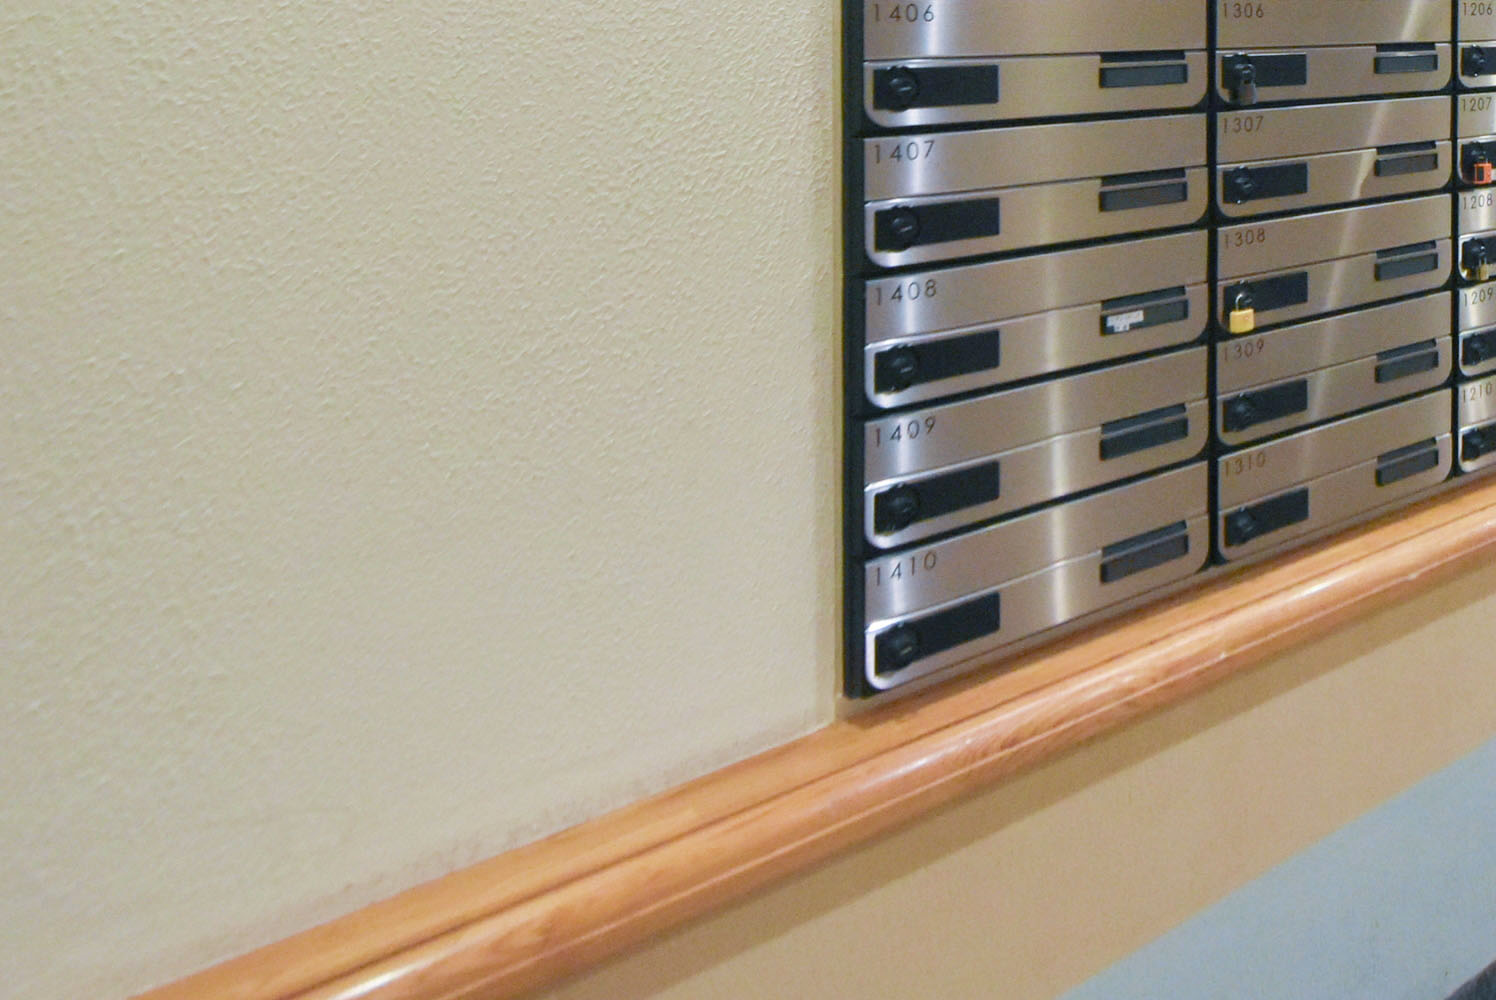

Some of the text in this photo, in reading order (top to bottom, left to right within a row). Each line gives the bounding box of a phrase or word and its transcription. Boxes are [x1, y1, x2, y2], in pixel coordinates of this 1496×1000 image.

[874, 3, 935, 23] 1406
[1222, 3, 1265, 19] 1306
[1462, 2, 1493, 17] 1206
[1462, 96, 1493, 113] 1207
[1222, 116, 1265, 134] 1307
[874, 140, 935, 164] 1407
[1463, 193, 1494, 211] 1208
[1223, 228, 1266, 250] 1308
[875, 280, 938, 306] 1408
[1463, 287, 1494, 308] 1209
[1222, 340, 1265, 361] 1309
[1463, 383, 1493, 402] 1210
[875, 416, 937, 448] 1409
[1225, 451, 1266, 477] 1310
[875, 551, 938, 587] 1410
